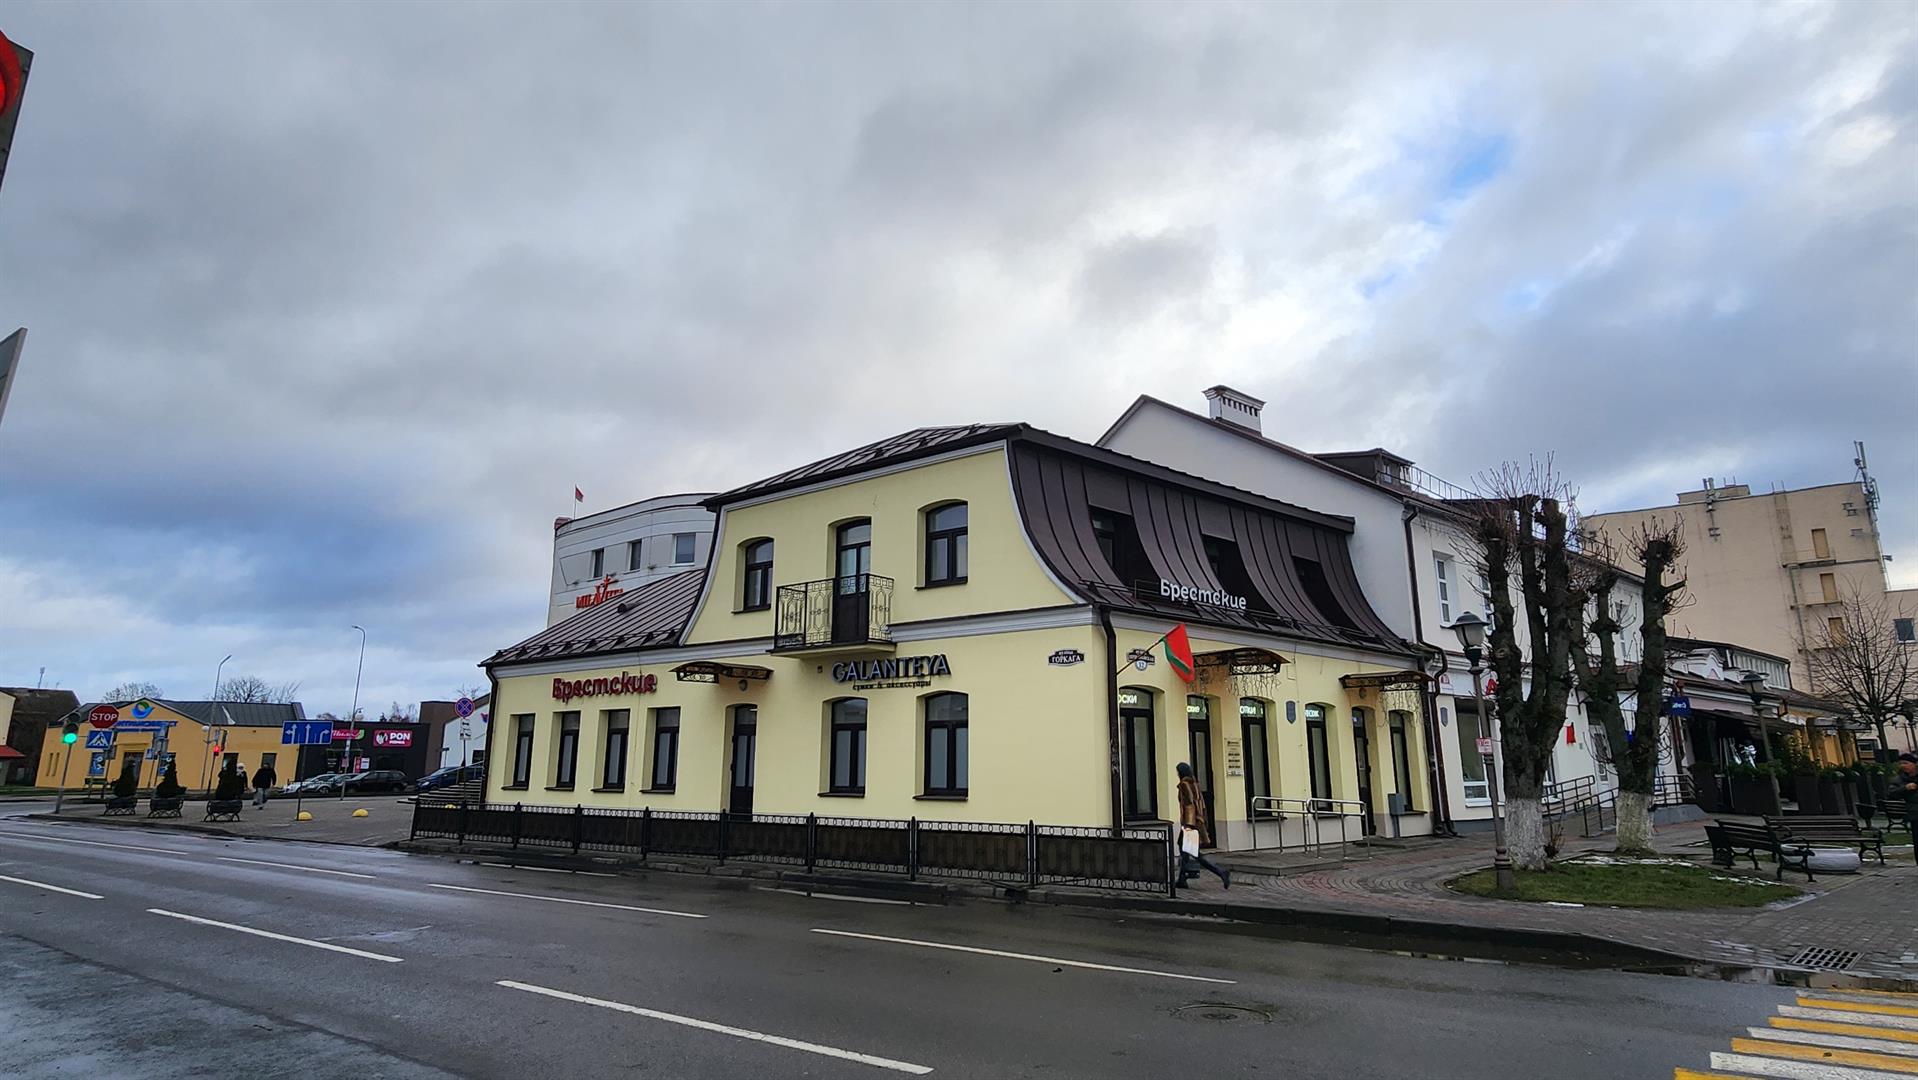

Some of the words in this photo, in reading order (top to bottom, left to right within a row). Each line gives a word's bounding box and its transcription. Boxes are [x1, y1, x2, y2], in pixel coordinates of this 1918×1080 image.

[1160, 578, 1247, 610] Брестские
[831, 653, 952, 683] GALANTEYA
[1051, 654, 1081, 663] ГОРКАГА
[552, 671, 657, 704] Брестские
[91, 712, 118, 721] STOP
[390, 732, 411, 741] PON
